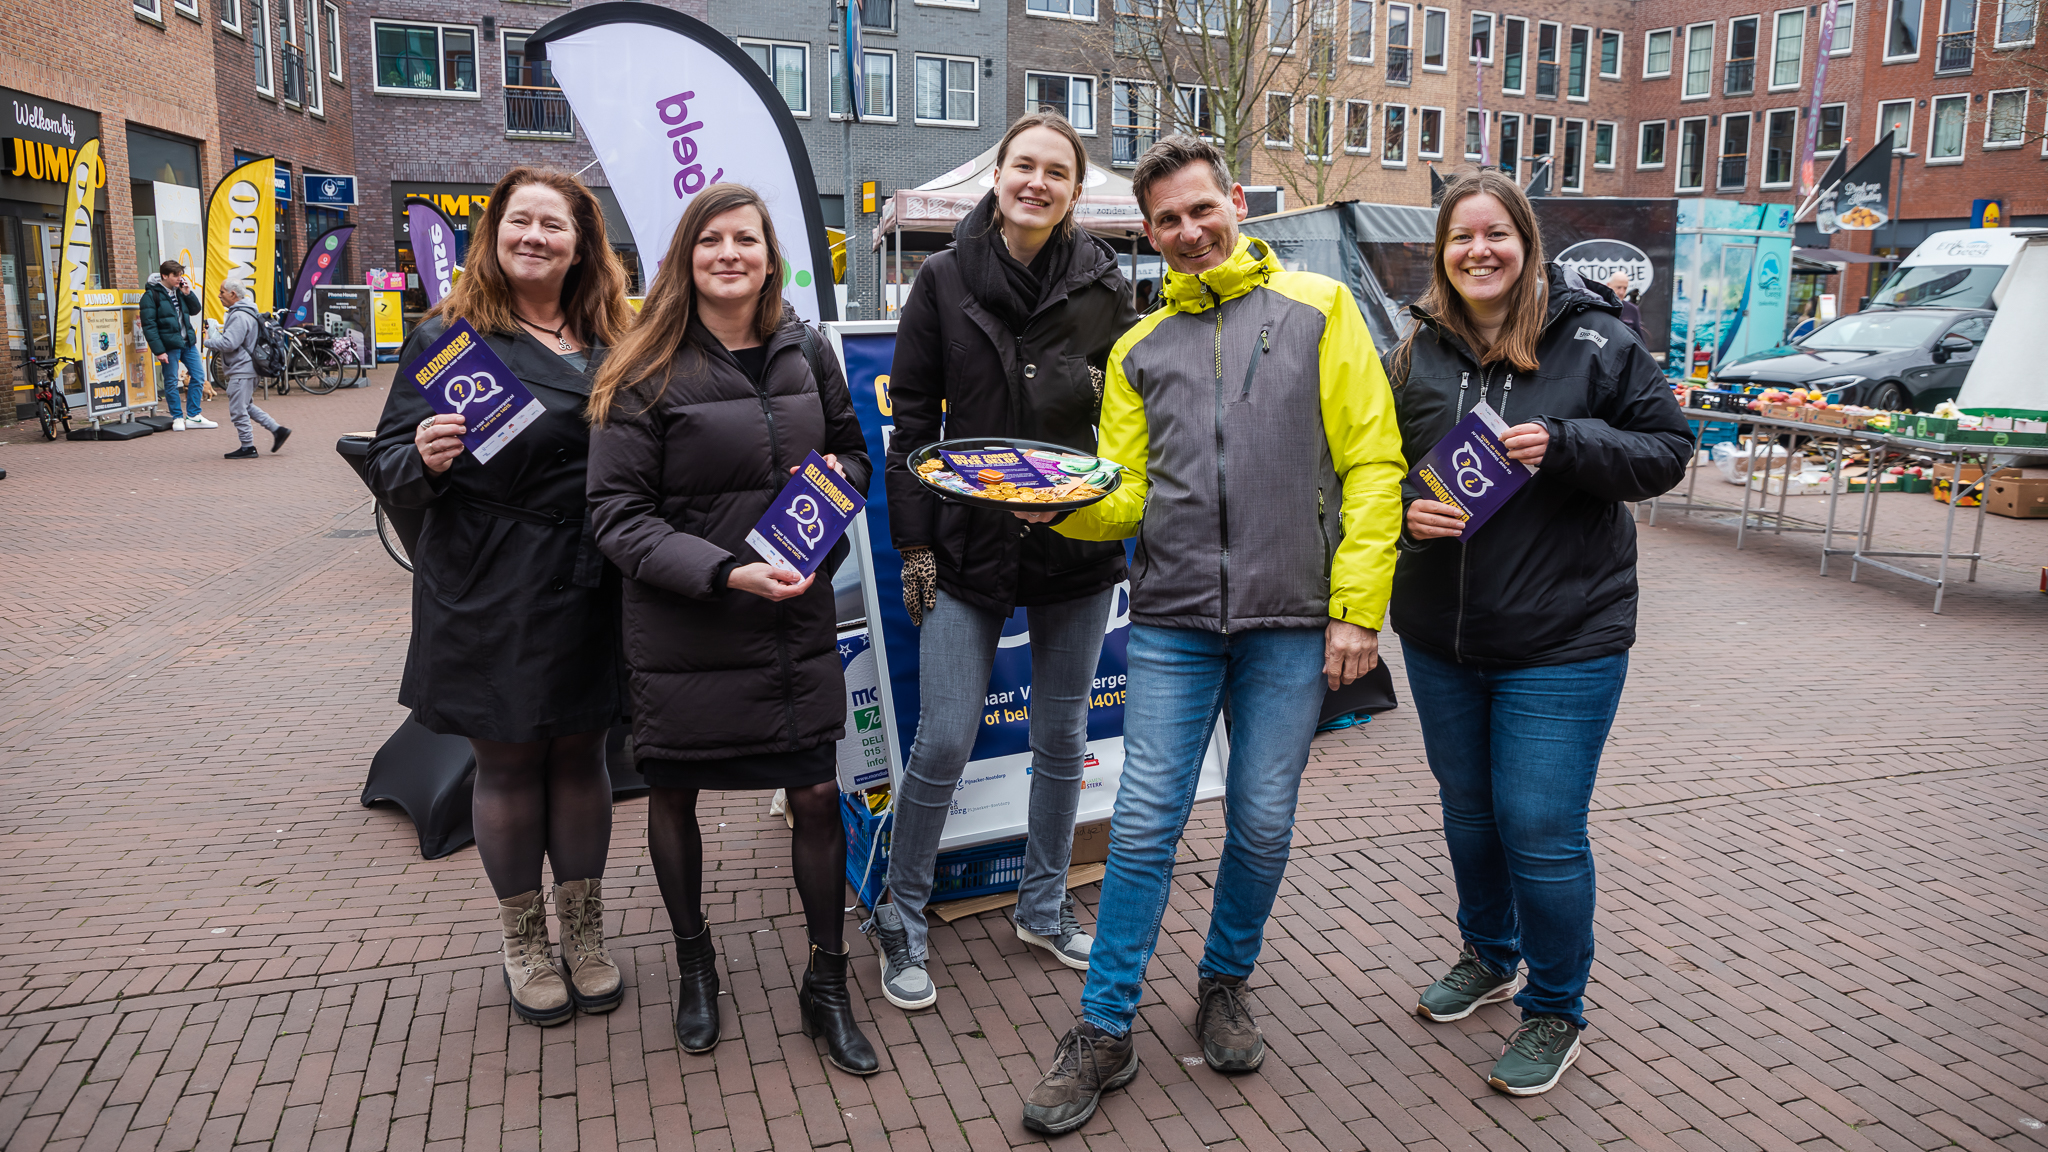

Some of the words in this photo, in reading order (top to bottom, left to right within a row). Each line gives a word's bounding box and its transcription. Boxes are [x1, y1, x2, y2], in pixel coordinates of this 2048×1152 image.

[13, 100, 62, 134] Welkom
[61, 113, 76, 144] bij
[12, 137, 106, 189] JUMO
[906, 197, 976, 219] BRO
[1096, 206, 1127, 215] zonder
[227, 180, 260, 303] MBO
[84, 292, 115, 305] JUMBO
[380, 303, 388, 312] 7
[415, 331, 470, 386] GELDZORGEN?
[94, 386, 120, 399] JUMBO
[804, 463, 855, 513] GELDZORGEN?
[1419, 468, 1470, 523] GDZORGEN?
[858, 710, 881, 733] Jo
[984, 712, 1000, 725] of
[1004, 706, 1029, 722] bel
[864, 747, 881, 757] 015
[964, 774, 1006, 785] Pijnacker-Nootdorp
